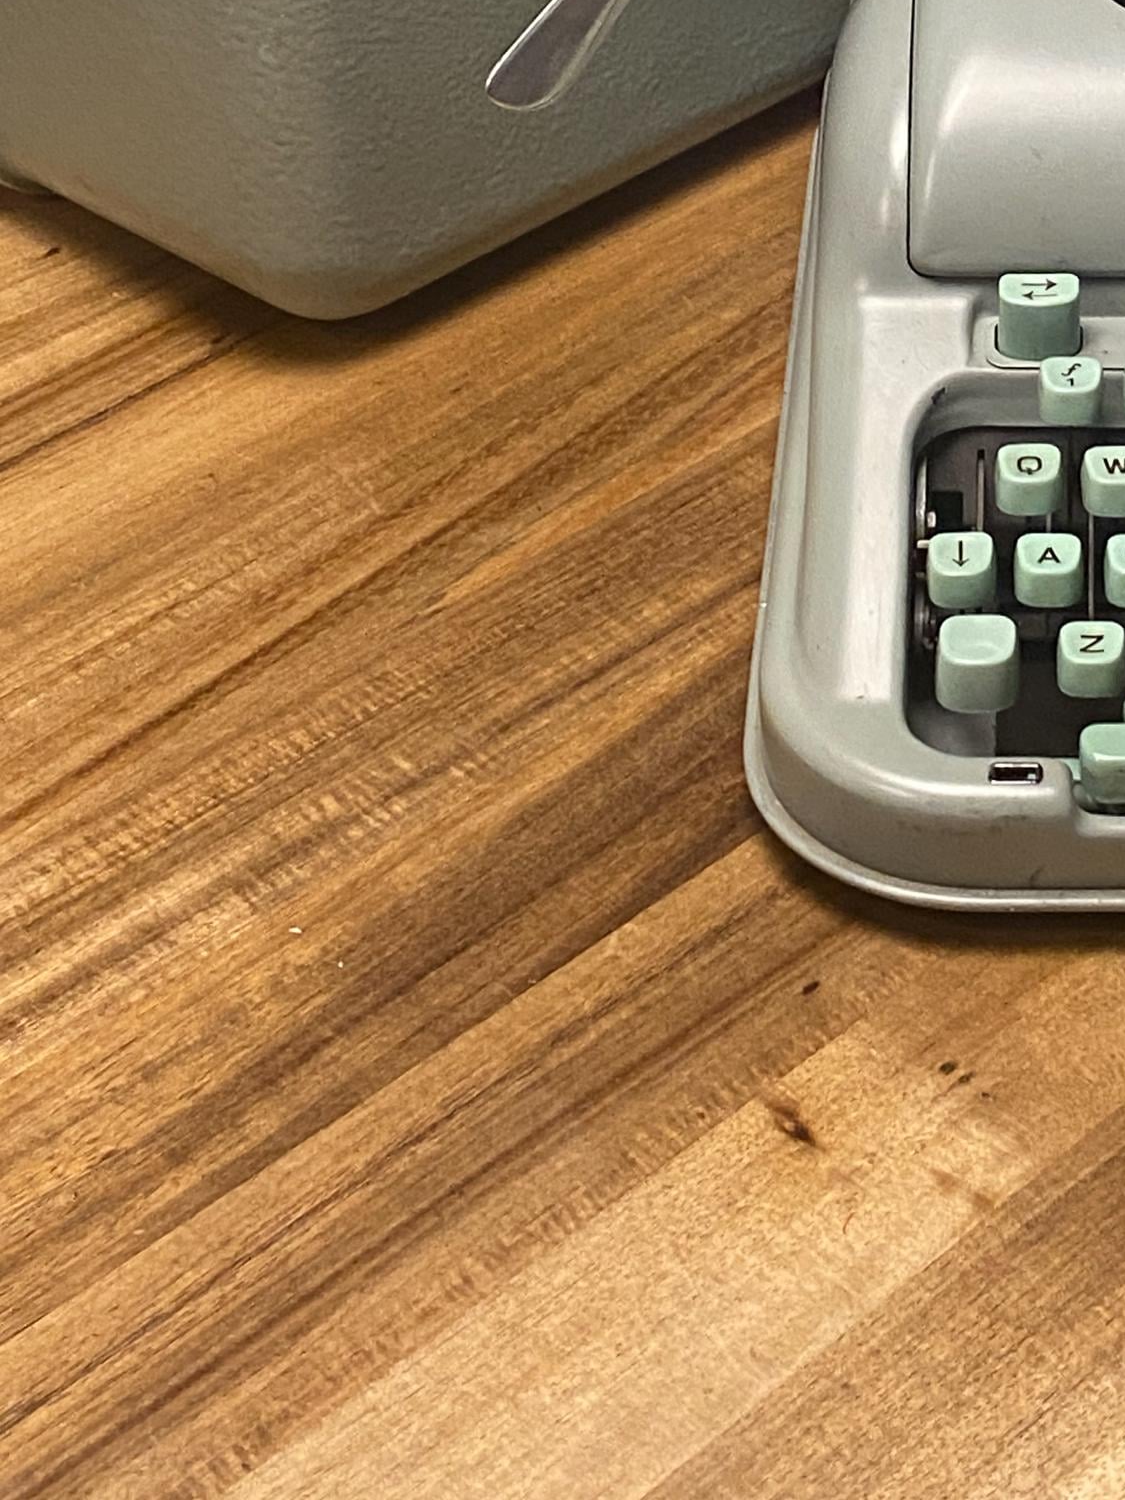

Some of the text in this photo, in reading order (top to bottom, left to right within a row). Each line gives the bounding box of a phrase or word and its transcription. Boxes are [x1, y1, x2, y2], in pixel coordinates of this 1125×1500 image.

[1016, 455, 1043, 476] Q
[1037, 546, 1061, 564] A
[1079, 634, 1105, 654] Z
